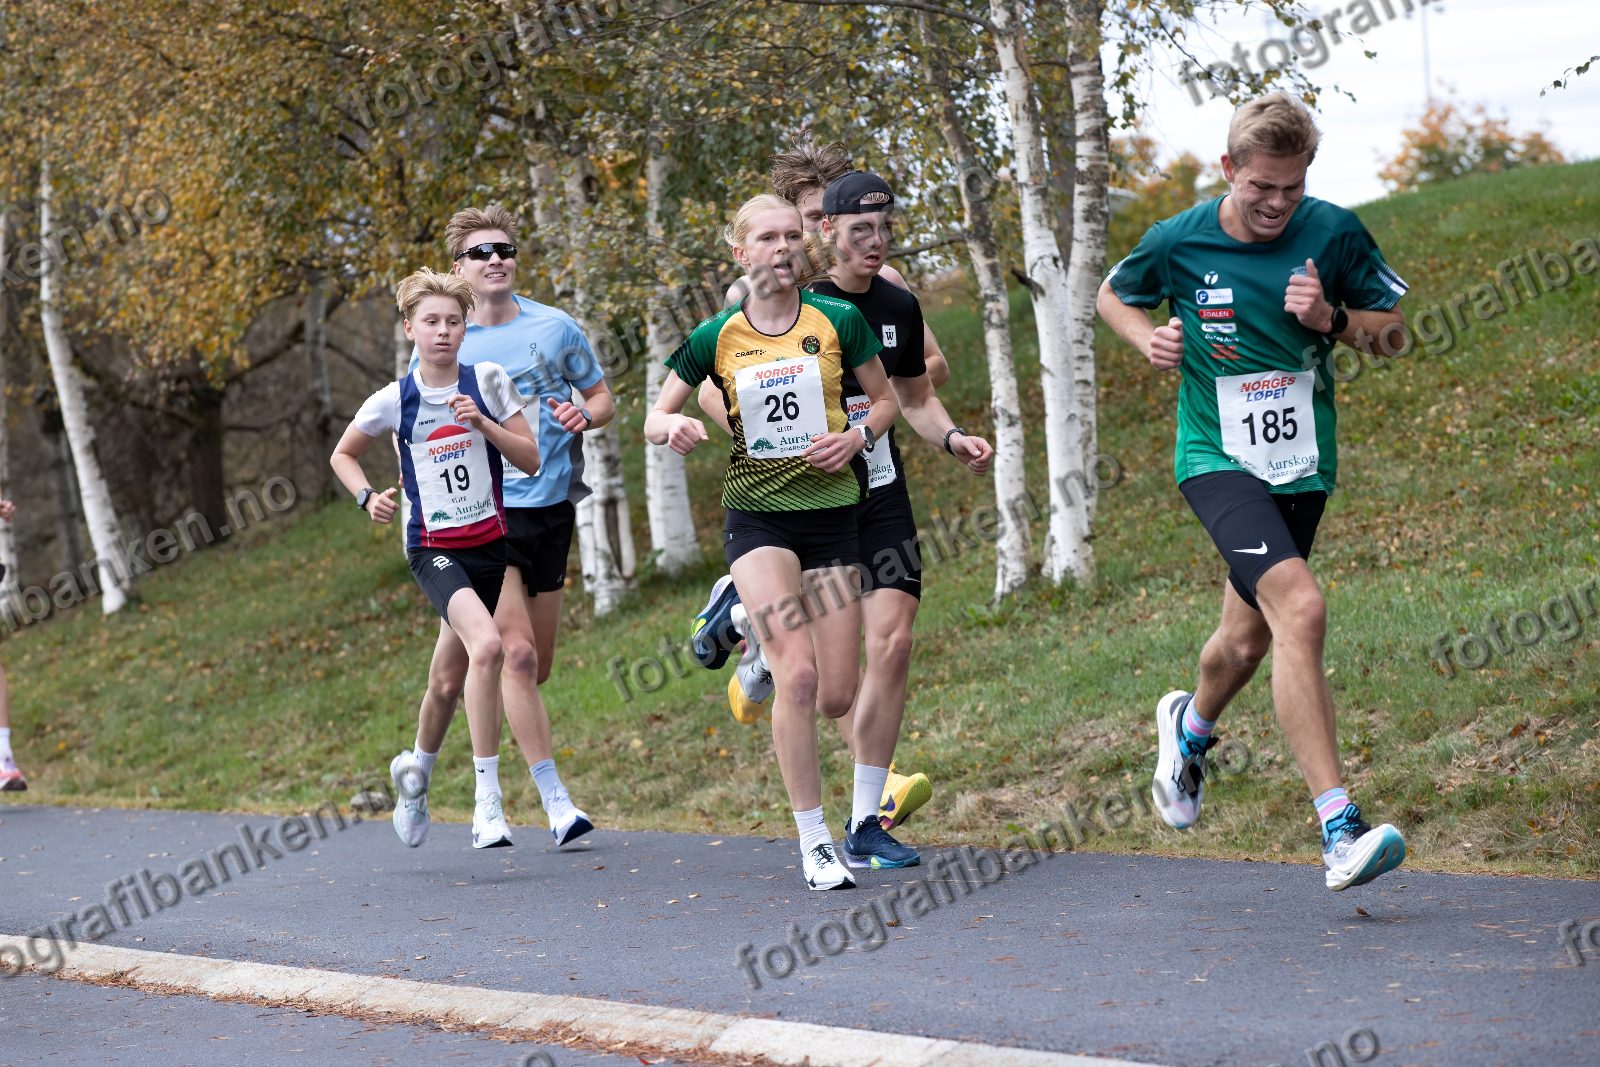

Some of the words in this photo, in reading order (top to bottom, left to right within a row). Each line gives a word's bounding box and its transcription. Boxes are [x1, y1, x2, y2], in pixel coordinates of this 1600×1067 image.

[735, 349, 759, 358] CRAFT
[755, 364, 804, 381] NORGES
[760, 374, 797, 389] LØPET
[1240, 376, 1297, 393] NORGES
[1246, 387, 1288, 403] LØPET
[764, 391, 800, 423] 26
[1241, 406, 1298, 446] 185
[779, 432, 820, 445] Aursk
[428, 439, 473, 457] NORGES
[433, 449, 467, 464] LØPET
[1267, 454, 1316, 472] Aurskog
[439, 464, 471, 494] 19
[455, 498, 493, 516] Aurskog
